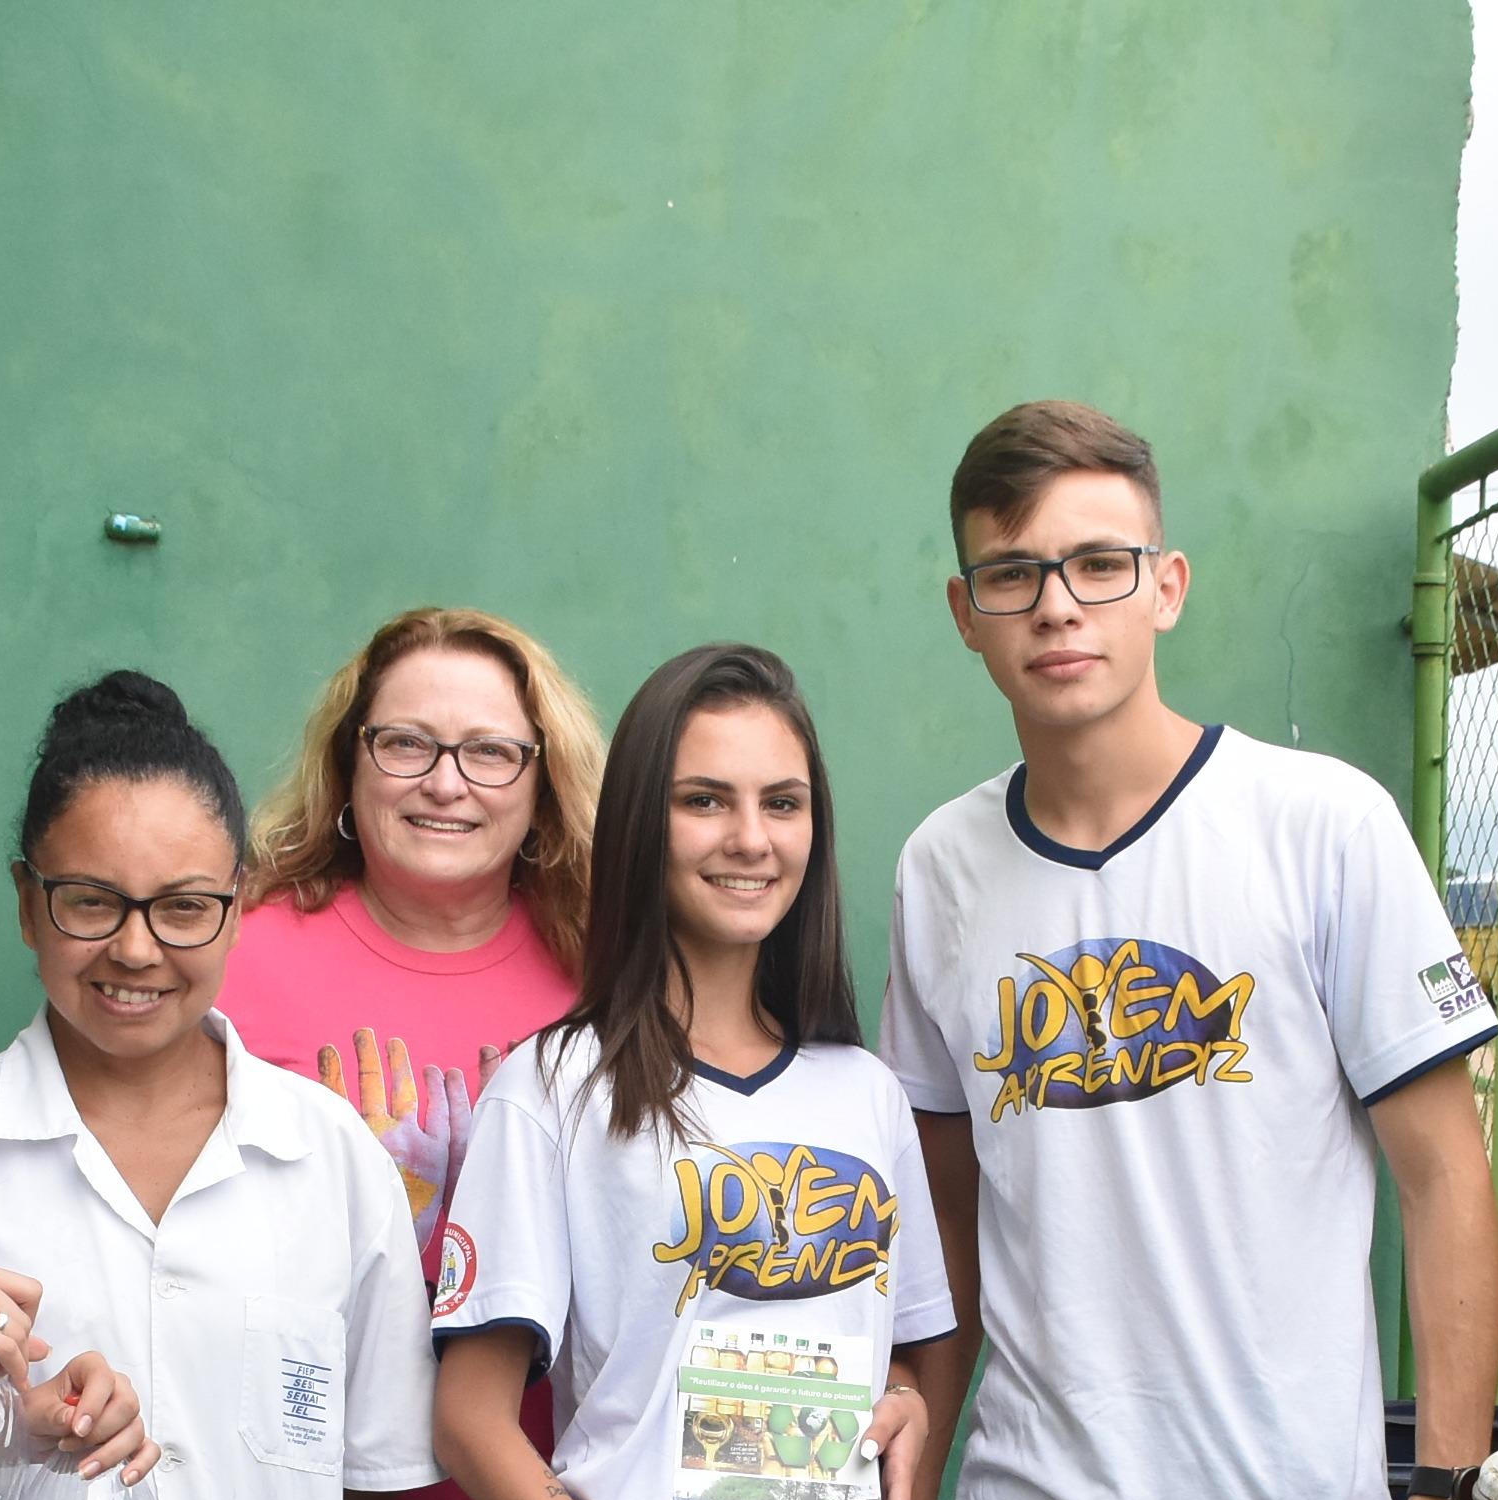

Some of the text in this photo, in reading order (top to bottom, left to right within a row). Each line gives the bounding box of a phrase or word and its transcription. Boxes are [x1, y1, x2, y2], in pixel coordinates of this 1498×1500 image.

[974, 939, 1255, 1072] JOVEM
[990, 1040, 1253, 1123] APRENDIZ
[297, 1366, 315, 1376] FIEP
[293, 1379, 315, 1390] SESI
[286, 1390, 319, 1404] SENAI
[291, 1404, 309, 1416] IEL
